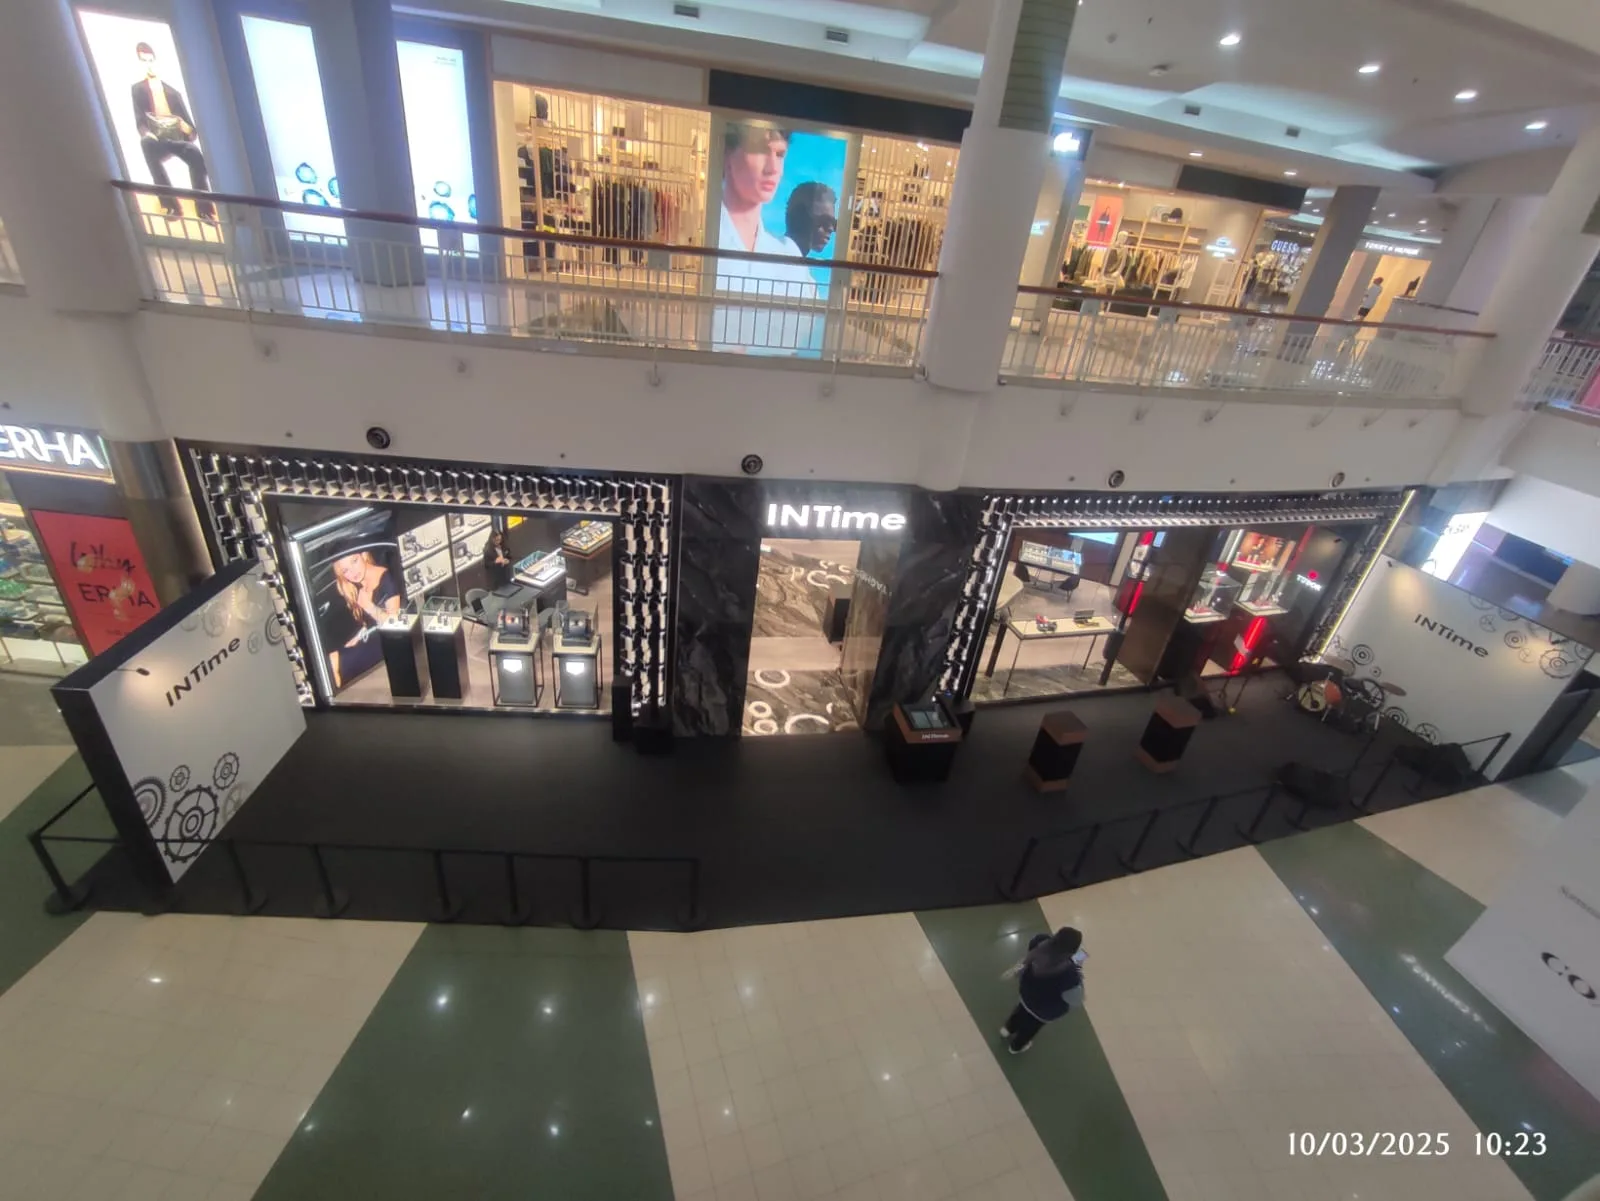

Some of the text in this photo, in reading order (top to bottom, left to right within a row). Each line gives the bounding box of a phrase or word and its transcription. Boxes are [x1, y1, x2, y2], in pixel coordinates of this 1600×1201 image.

[1271, 240, 1299, 254] GUESS
[767, 503, 907, 530] INTime
[1414, 613, 1489, 658] INTime
[166, 637, 240, 707] INTime
